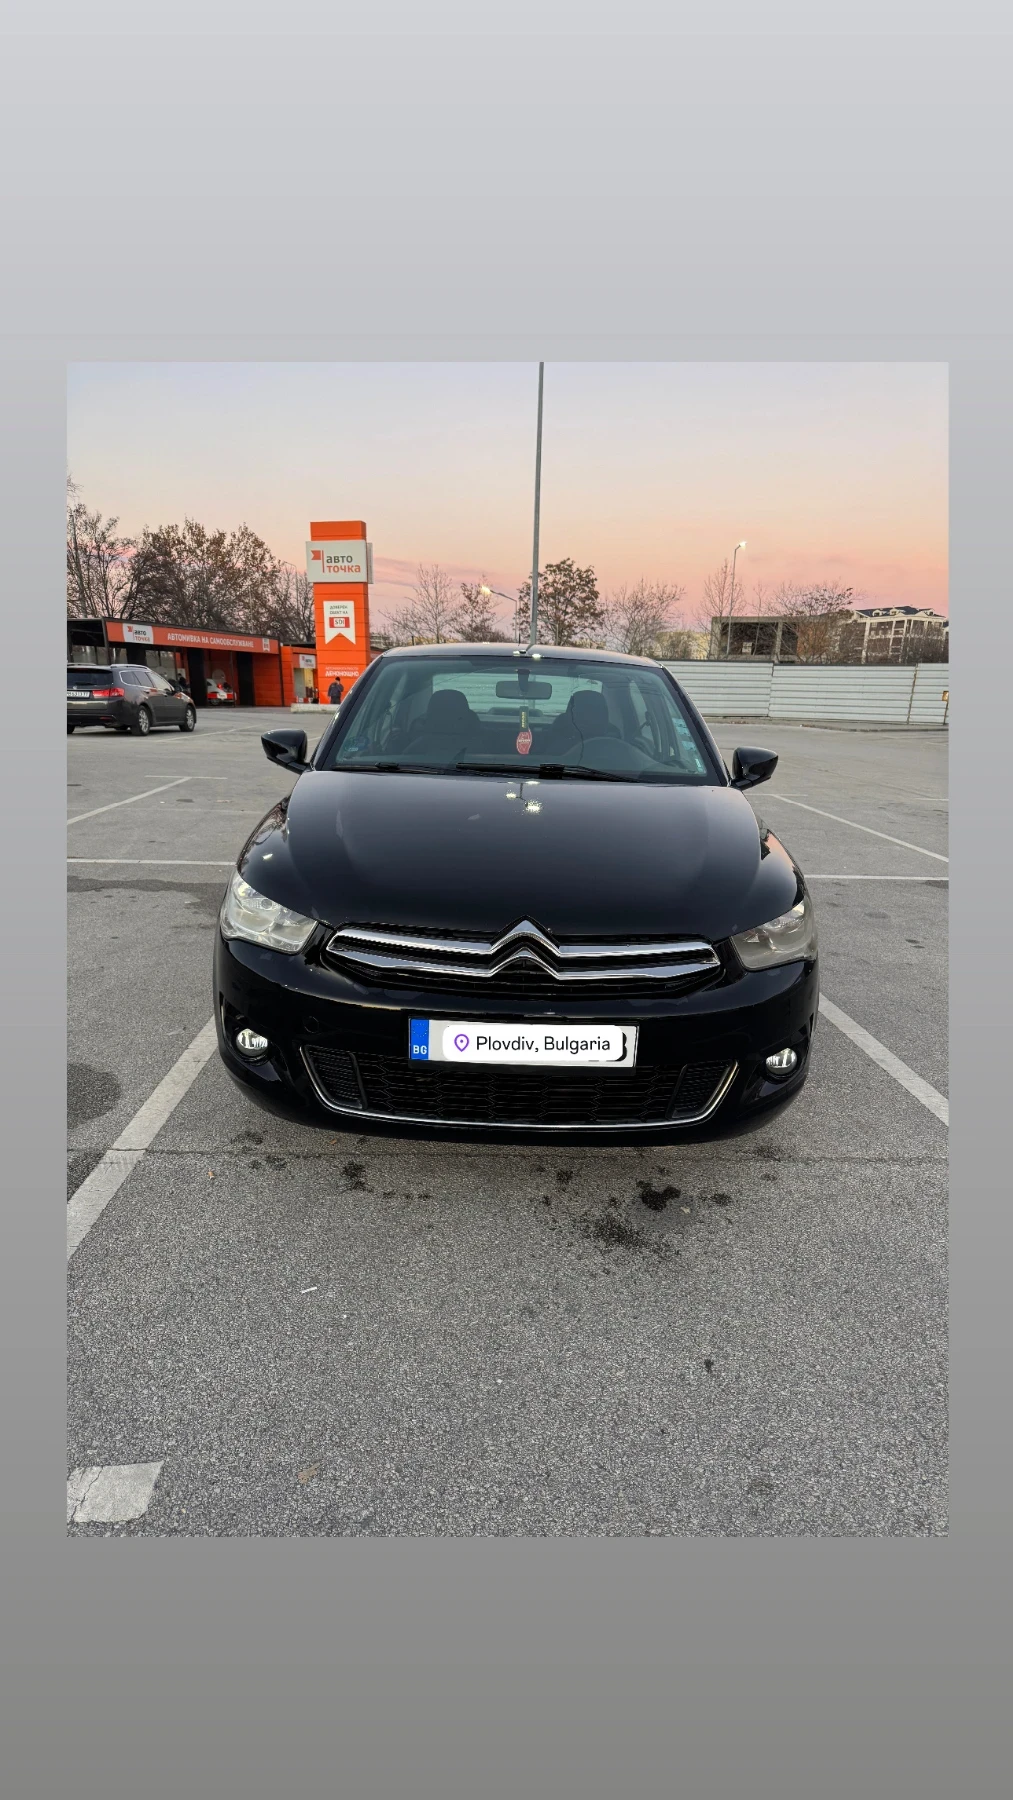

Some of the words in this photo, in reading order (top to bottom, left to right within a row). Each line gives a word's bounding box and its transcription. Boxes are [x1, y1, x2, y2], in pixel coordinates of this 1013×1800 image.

[326, 555, 353, 564] авто
[326, 564, 361, 573] точка
[167, 632, 201, 643] АВТОМИВКА
[210, 637, 254, 648] САМООБСЛУЖВАНЕ
[413, 1044, 428, 1055] BG
